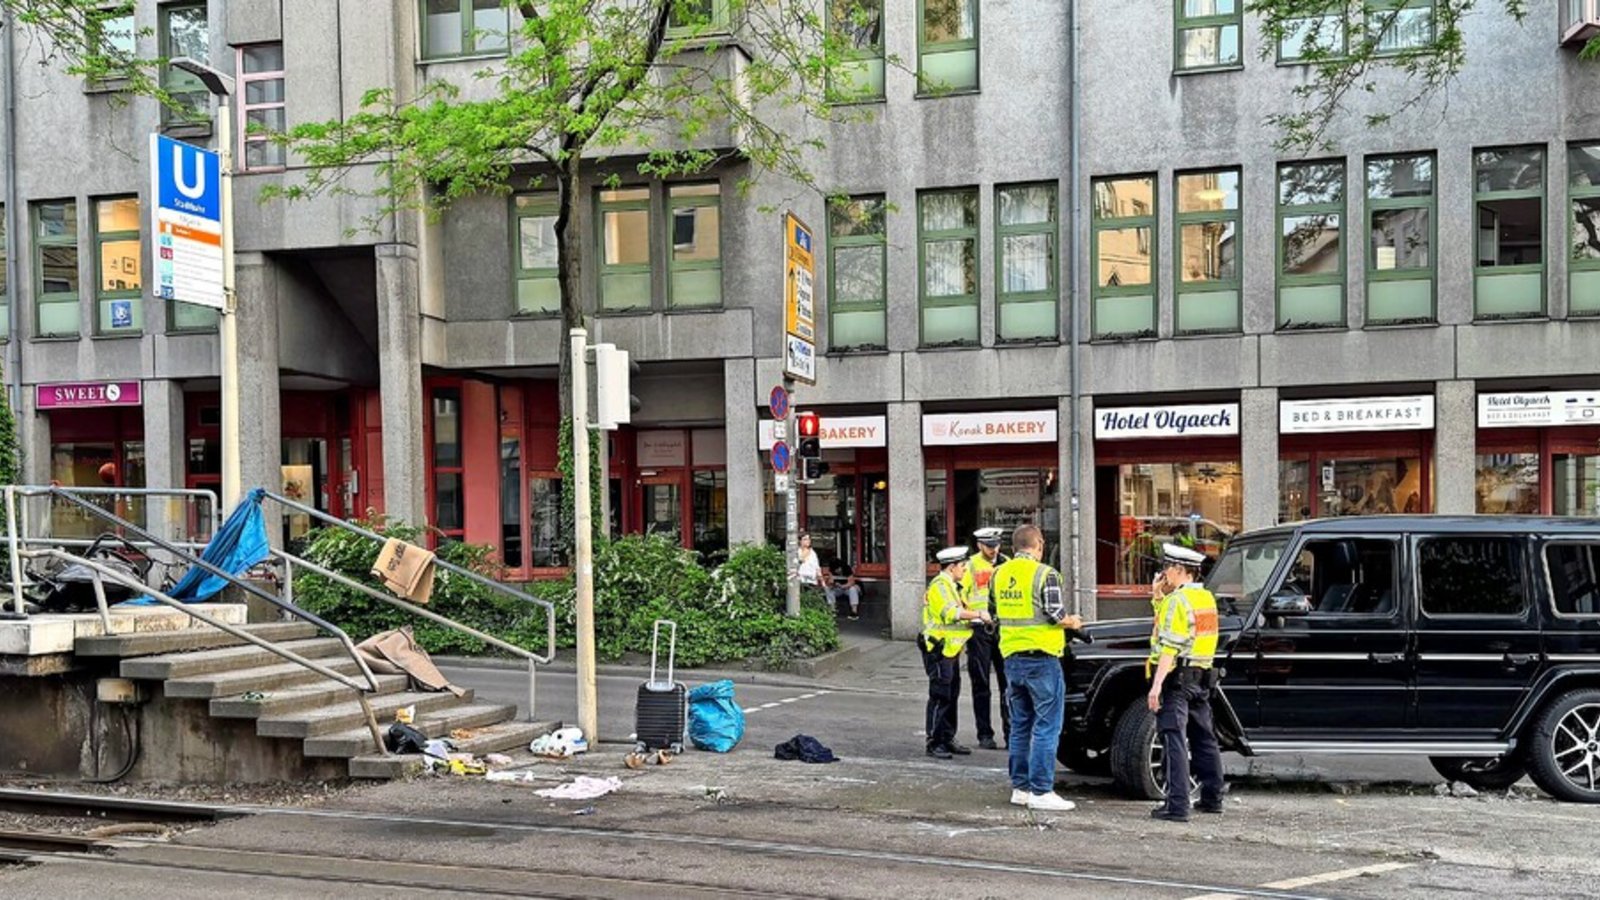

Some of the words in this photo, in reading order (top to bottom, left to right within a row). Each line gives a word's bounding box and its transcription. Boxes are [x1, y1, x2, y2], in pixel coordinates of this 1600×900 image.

[173, 143, 206, 199] U
[1102, 411, 1150, 430] Hotel
[1154, 408, 1231, 433] Olgaeck
[1293, 411, 1320, 423] BED
[1324, 411, 1332, 421] &
[1337, 407, 1422, 421] BREAKFAST
[819, 426, 877, 440] BAKERY
[985, 421, 1047, 435] BAKERY
